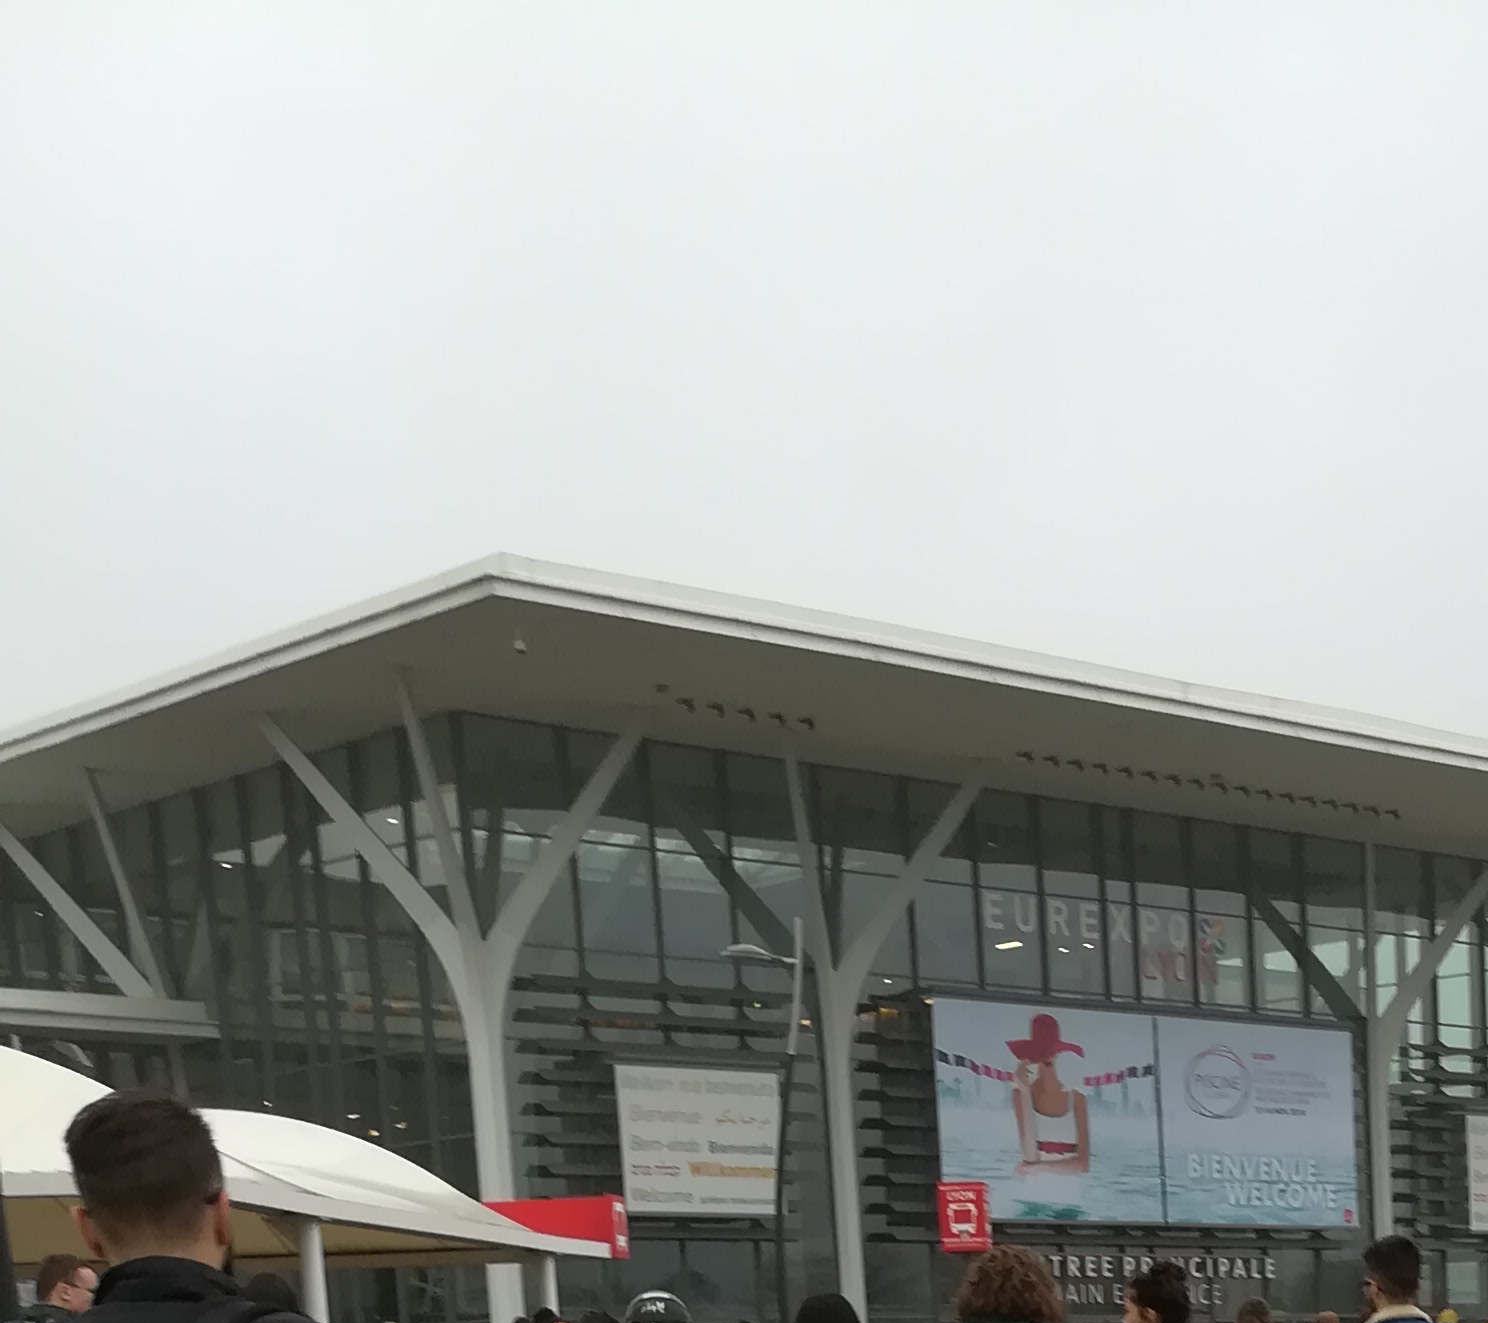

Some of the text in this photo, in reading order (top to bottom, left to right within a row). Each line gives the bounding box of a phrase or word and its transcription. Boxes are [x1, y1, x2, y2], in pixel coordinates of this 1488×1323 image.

[983, 891, 1190, 950] EUREXPO
[1187, 1153, 1317, 1182] BIENVENUE
[1225, 1182, 1338, 1208] WELCOME
[1040, 1255, 1277, 1279] TREE PRCIPALE
[1057, 1283, 1105, 1305] AIN
